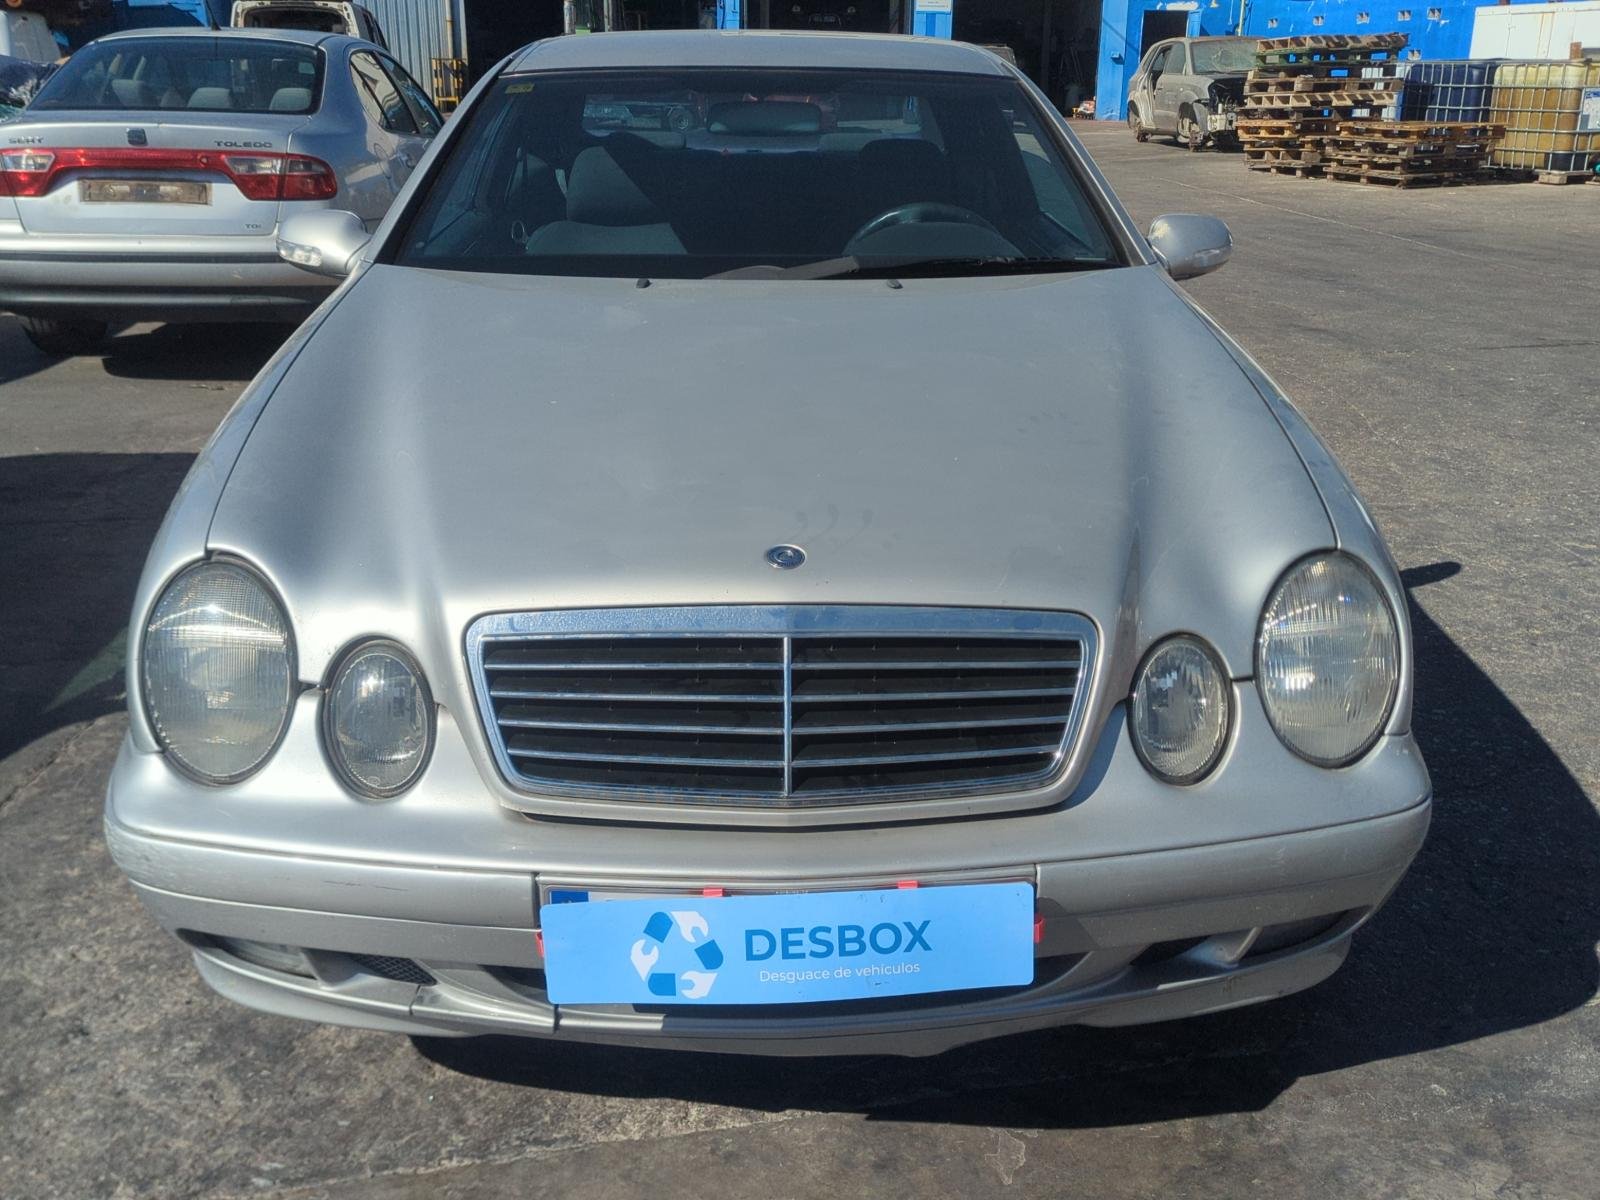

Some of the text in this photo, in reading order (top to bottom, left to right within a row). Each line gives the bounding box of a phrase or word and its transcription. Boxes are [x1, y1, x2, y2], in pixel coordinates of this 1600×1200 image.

[214, 140, 273, 148] TOLEDO
[745, 920, 932, 961] DESBOX
[759, 969, 831, 984] Desguace
[834, 966, 851, 978] de
